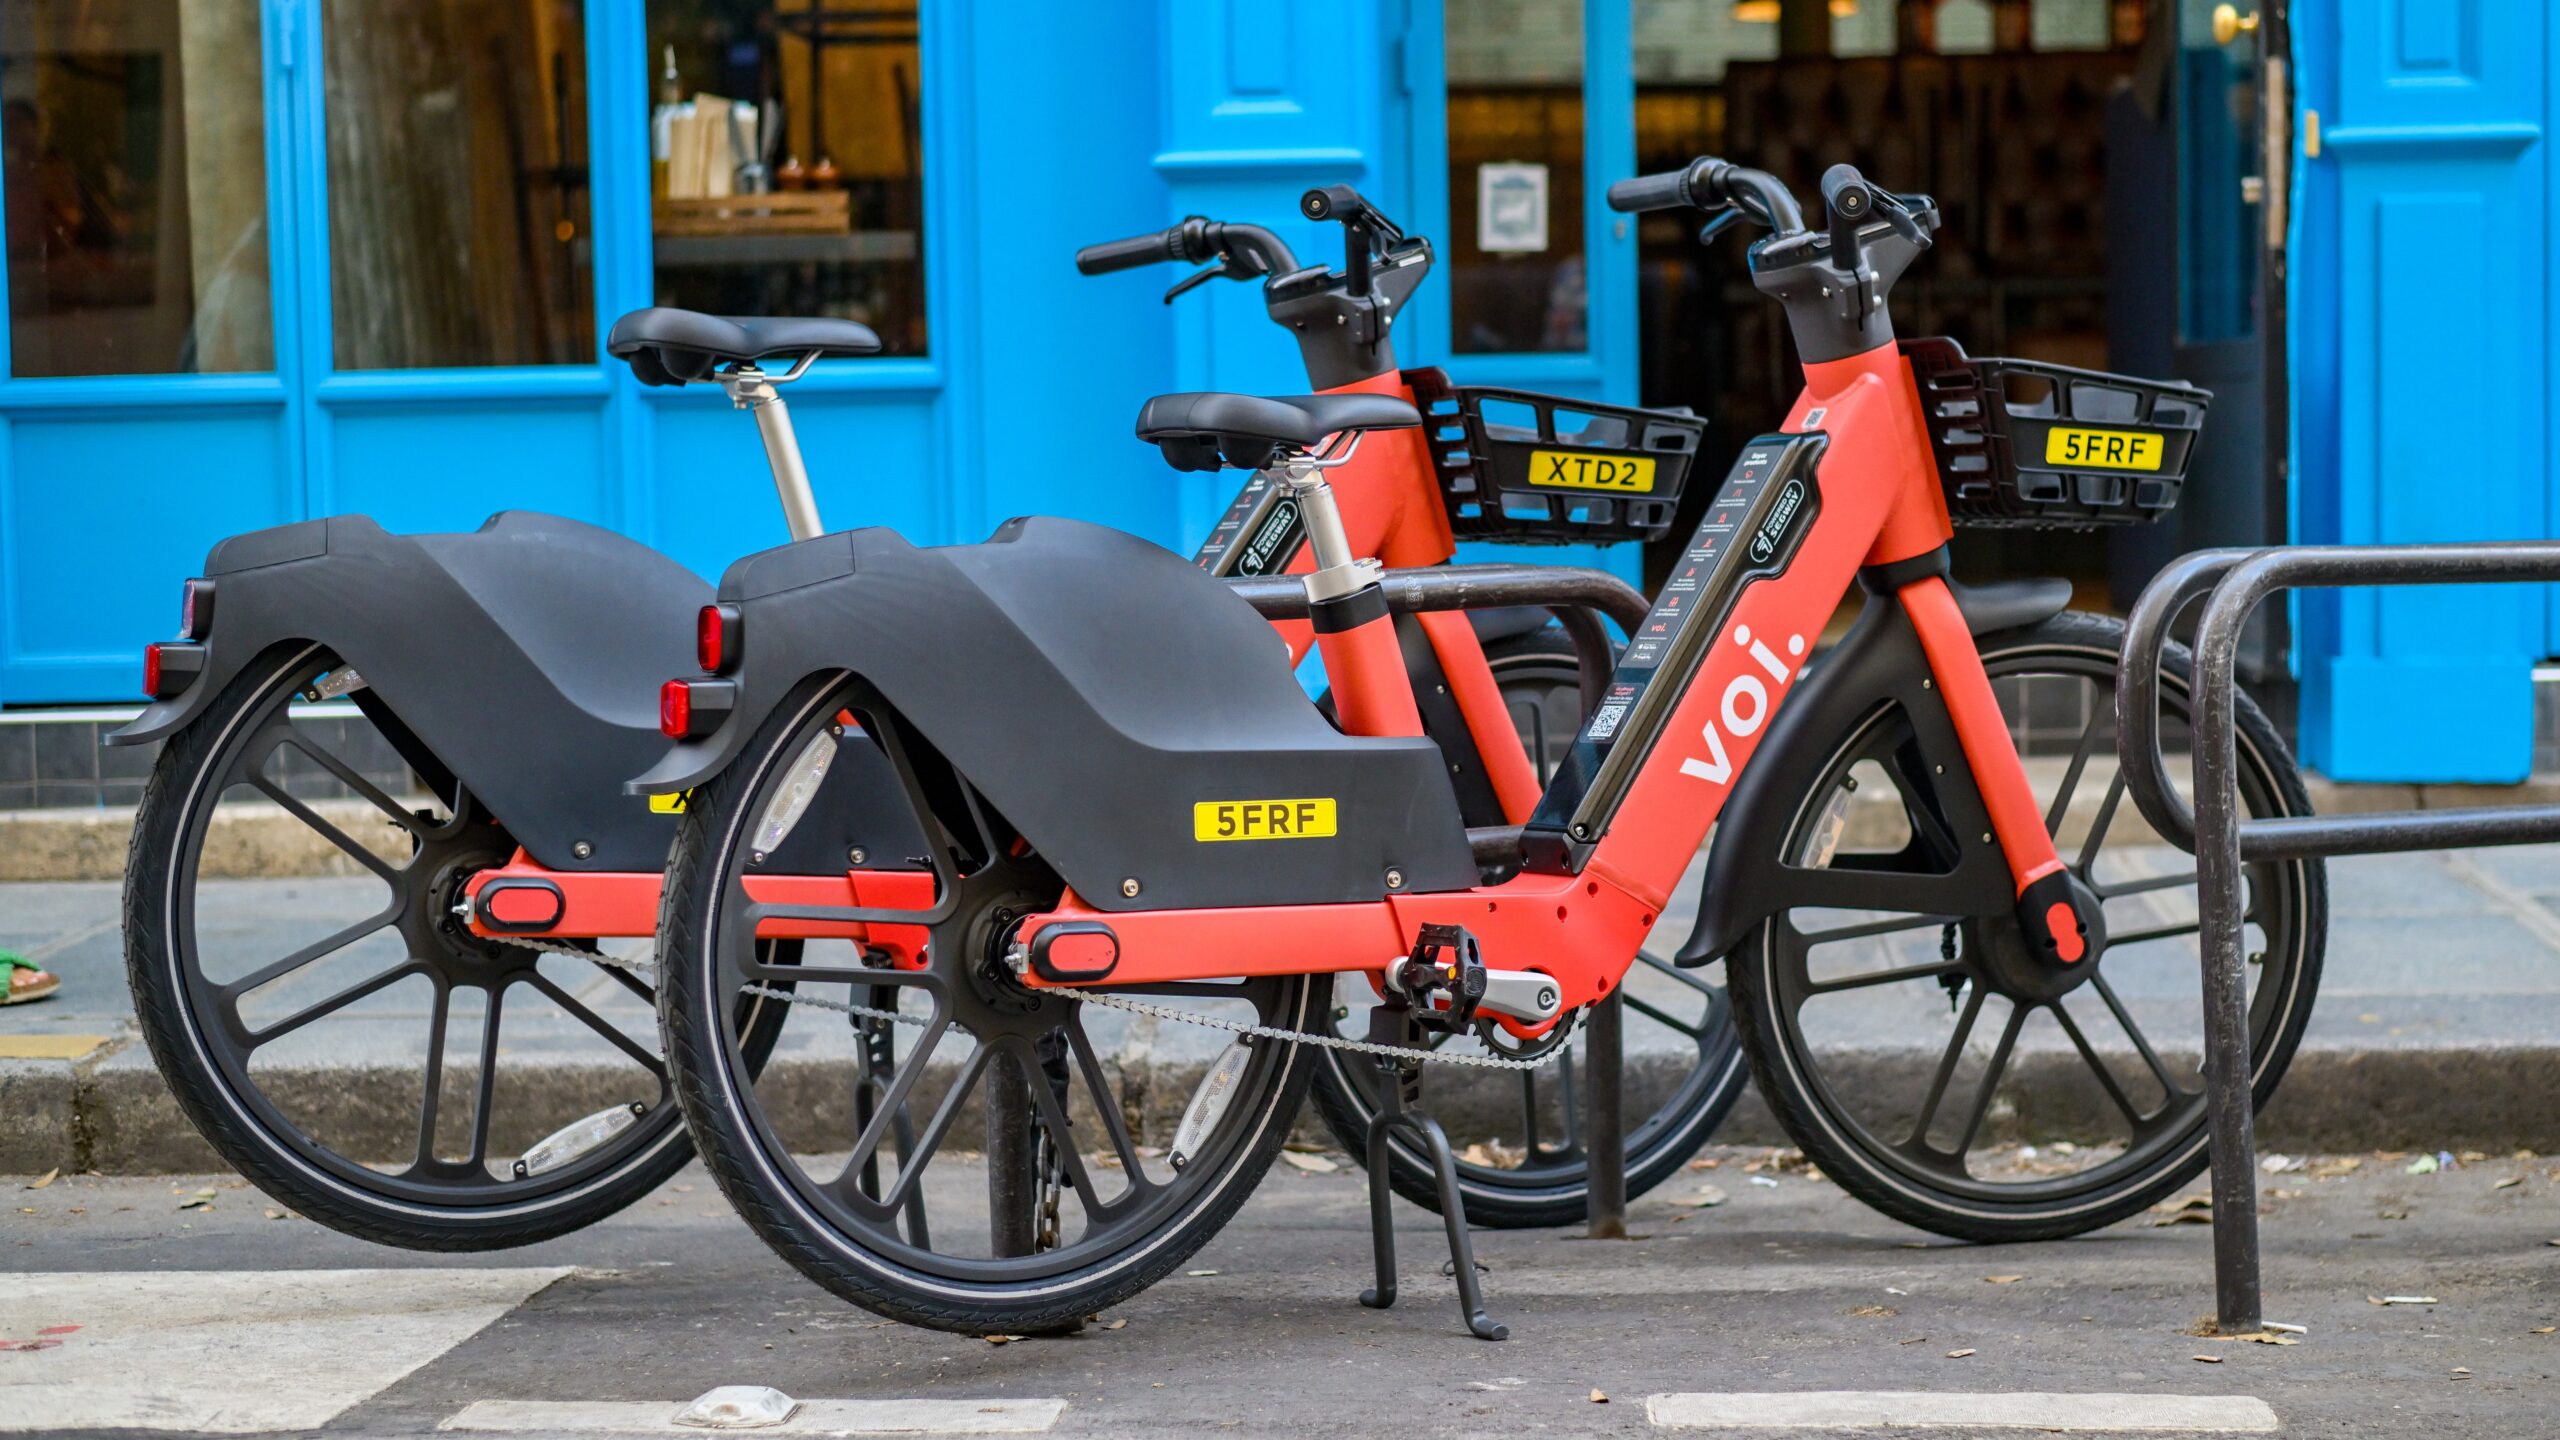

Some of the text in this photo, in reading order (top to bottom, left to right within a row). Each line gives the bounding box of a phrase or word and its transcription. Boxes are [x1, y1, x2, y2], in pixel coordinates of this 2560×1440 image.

[2065, 434, 2146, 464] 5FRF
[1547, 456, 1638, 487] XTD2
[1255, 507, 1287, 550] POWERED BY
[1765, 486, 1793, 533] POWERED BY
[1770, 490, 1799, 538] SEGWAY
[1260, 511, 1292, 555] SEGWAY
[1679, 624, 1805, 786] voi.
[1217, 803, 1316, 837] 5FRF
